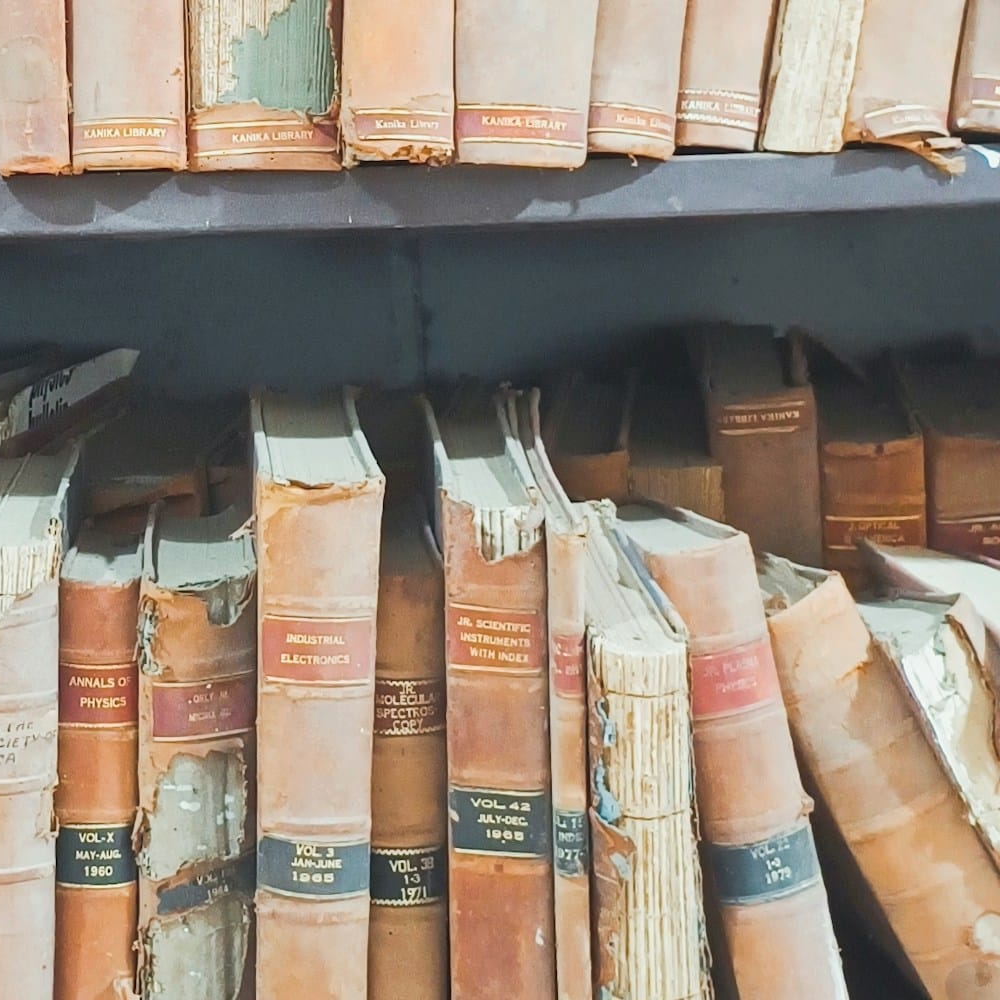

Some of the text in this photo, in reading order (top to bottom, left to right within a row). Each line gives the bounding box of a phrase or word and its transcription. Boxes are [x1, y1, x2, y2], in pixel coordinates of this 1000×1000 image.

[680, 99, 721, 113] KANIKA
[481, 115, 568, 132] KANIKA LIBRARY
[83, 126, 167, 140] KANIKA LIBRARY
[231, 130, 314, 144] KANIKA LIBRARY
[475, 619, 531, 634] SCIENTIFIC
[285, 633, 346, 646] INDUSTRIAL
[459, 631, 531, 648] INSTRUMENTS
[280, 653, 351, 666] ELECTRONICS
[469, 646, 530, 664] WITH INDEX
[68, 675, 115, 689] ANNALS
[79, 696, 127, 709] PHYSICS
[508, 801, 532, 813] 42
[485, 828, 525, 842] 1965
[295, 843, 336, 859] VOL. 3
[290, 857, 343, 870] JAN-JUNE
[388, 859, 418, 873] VOL.
[83, 865, 114, 878] 1960
[291, 870, 336, 884] 1965
[400, 886, 428, 902] 1971
